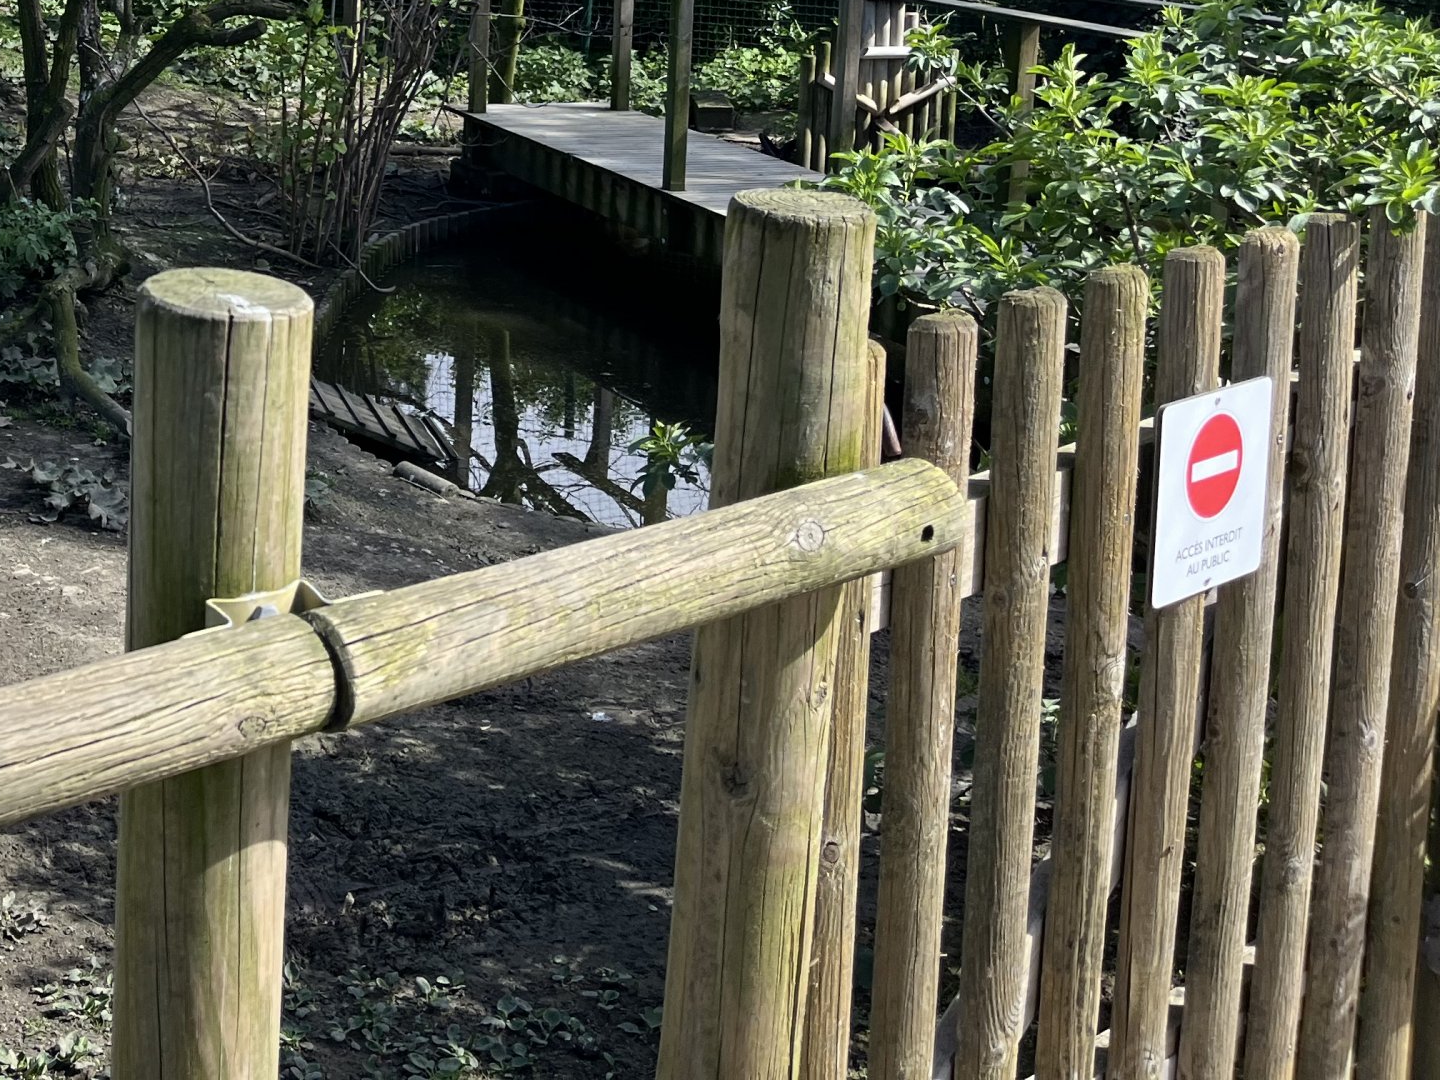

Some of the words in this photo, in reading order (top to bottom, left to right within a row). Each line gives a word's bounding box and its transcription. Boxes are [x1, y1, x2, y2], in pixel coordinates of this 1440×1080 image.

[1175, 540, 1203, 563] ACCÈS
[1204, 527, 1244, 552] INTERDIT
[1186, 561, 1200, 577] AU
[1201, 550, 1230, 571] PUBLIC
